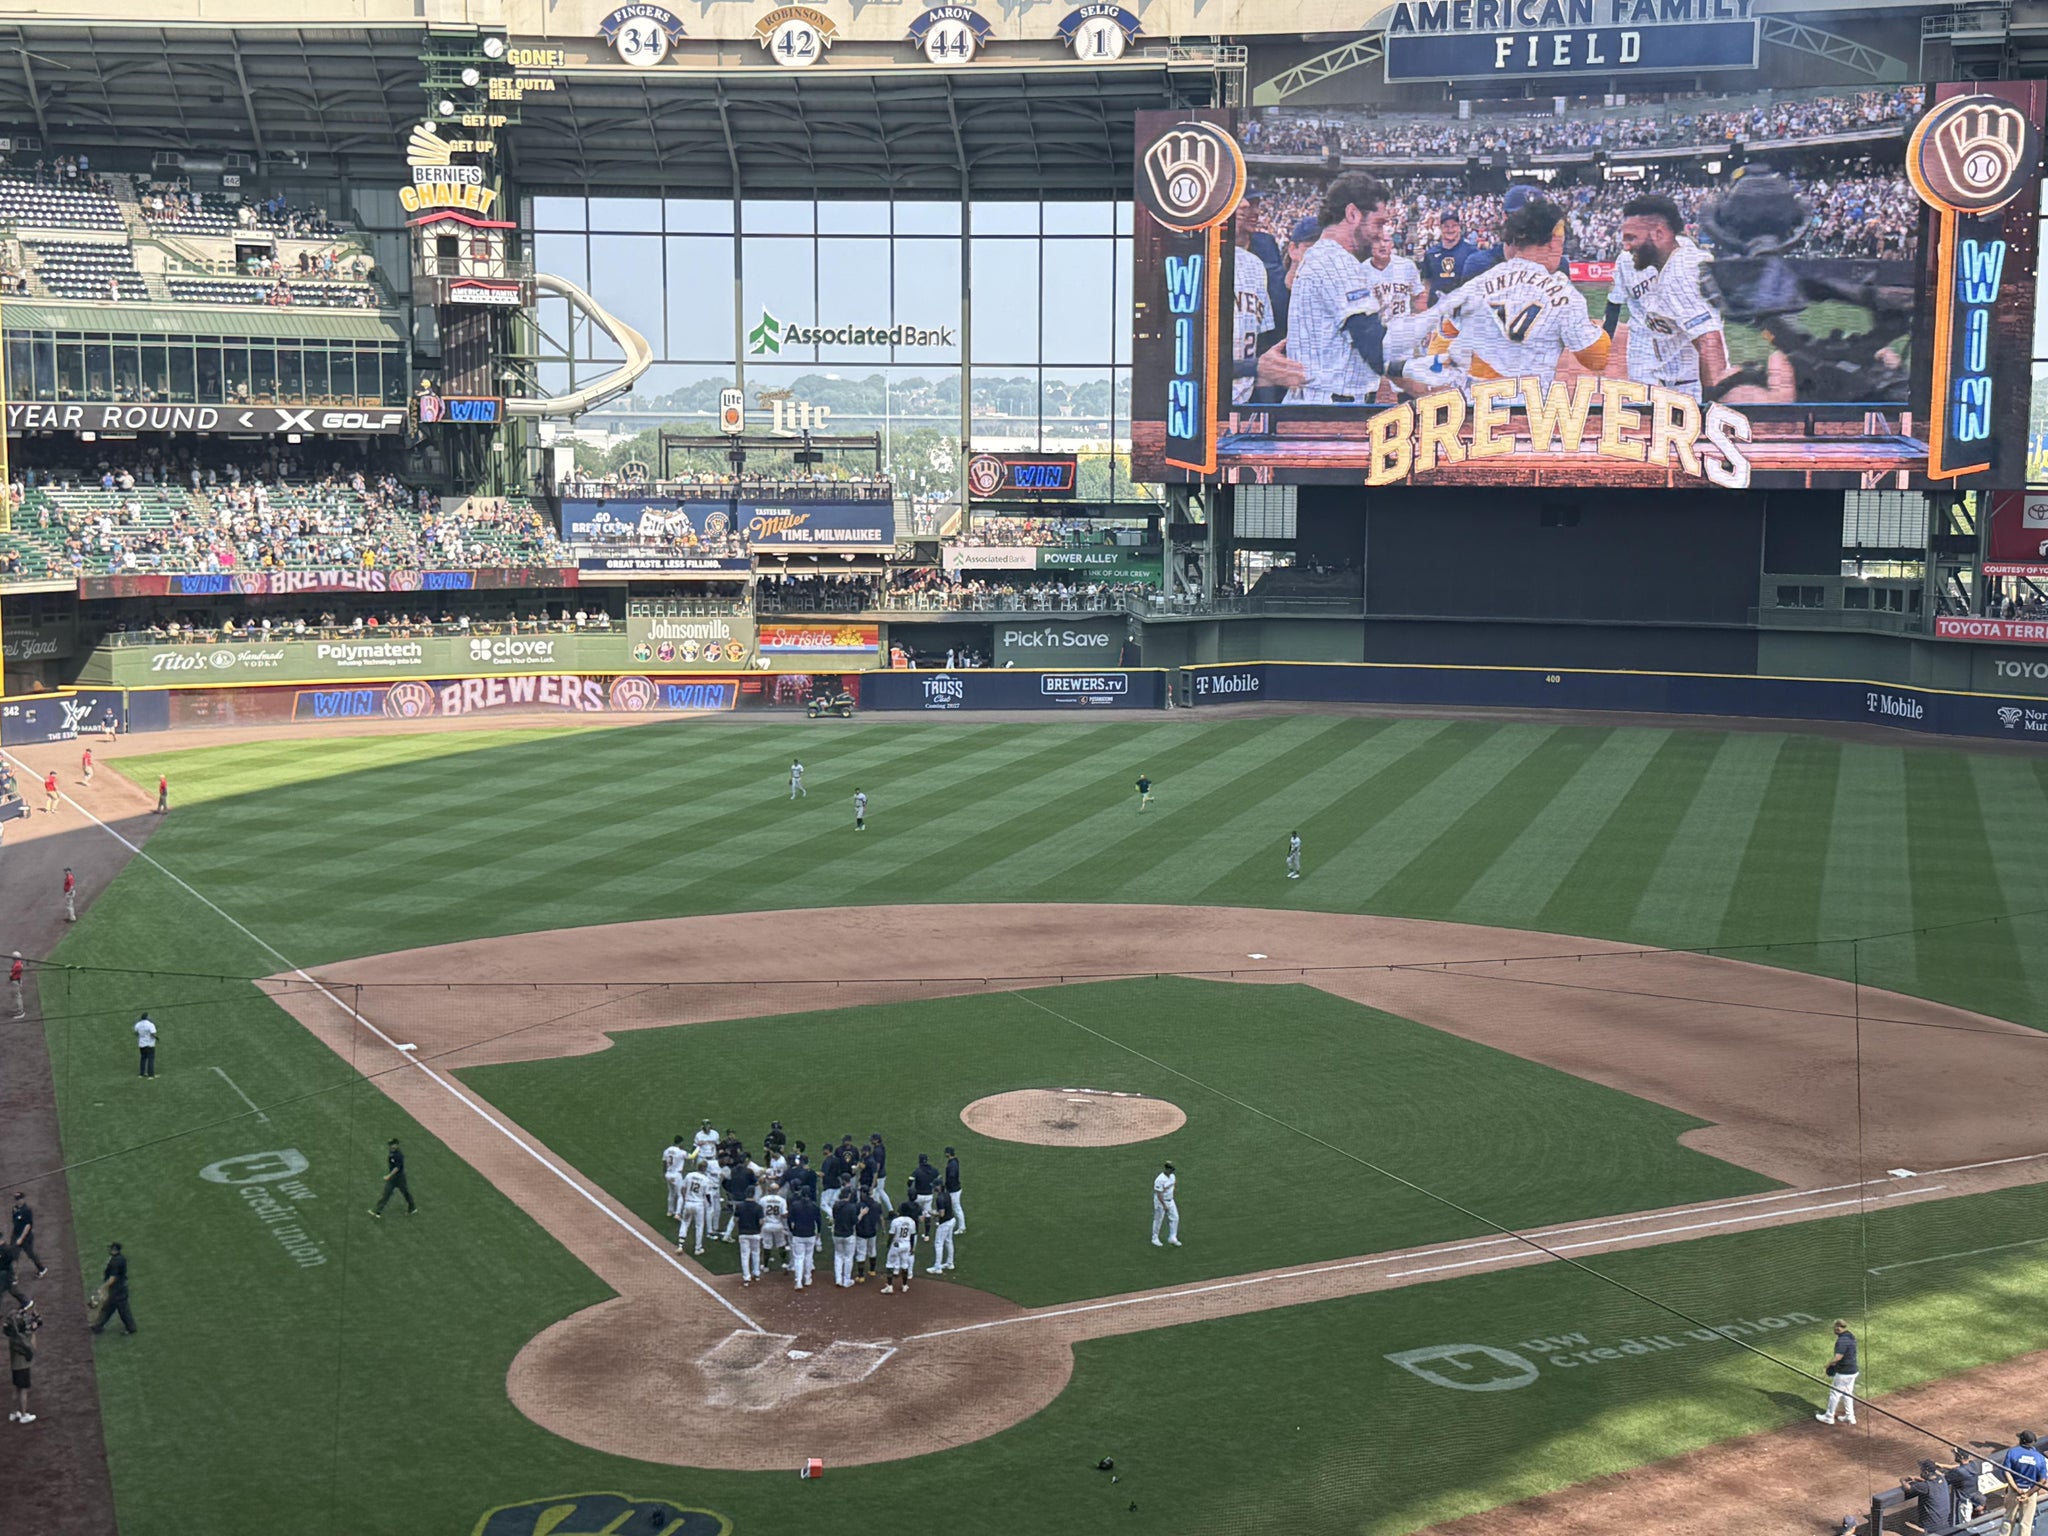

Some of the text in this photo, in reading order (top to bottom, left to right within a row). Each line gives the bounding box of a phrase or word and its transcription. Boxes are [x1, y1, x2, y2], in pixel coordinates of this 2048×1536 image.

[614, 5, 671, 23] FINGERS
[764, 9, 826, 26] ROBINSON
[928, 8, 972, 21] AARON
[1080, 5, 1119, 19] SELIG
[1390, 0, 1750, 32] AMERICAN FAMILY
[624, 29, 661, 56] 34
[777, 30, 815, 56] 42
[931, 30, 969, 57] 44
[1093, 30, 1109, 57] 1
[1494, 32, 1641, 69] FIELD
[507, 49, 565, 66] GONE!
[489, 78, 556, 91] GET OUTTA
[489, 89, 523, 100] HERE
[462, 115, 507, 127] GET UP
[450, 140, 494, 152] GET UP
[415, 167, 481, 182] BERNIE'S
[399, 183, 498, 214] CHALET
[1483, 270, 1570, 308] ONTRERAS
[723, 394, 742, 407] Lite
[7, 405, 84, 428] YEAR
[101, 406, 219, 429] ROUND
[321, 413, 403, 430] GOLF
[450, 400, 496, 421] WIN
[770, 399, 832, 438] Lite
[1365, 375, 1753, 490] BREWERS
[1014, 466, 1063, 487] WIN
[595, 512, 611, 523] GO
[755, 508, 791, 516] TASTES LIKE
[750, 513, 811, 540] Miller
[780, 529, 882, 542] TIME, MILWAUKEE
[606, 559, 722, 569] GREAT TASTE. LESS FILLING.
[1044, 553, 1119, 564] POWER ALLEY
[1984, 565, 2025, 574] COURTESY
[2026, 566, 2038, 574] OF
[180, 574, 223, 593] WIN
[270, 569, 386, 594] BREWERS
[427, 572, 469, 590] WIN
[647, 619, 730, 640] Johnsonville
[772, 628, 833, 648] Surfside
[1939, 621, 2001, 637] TOYOTA
[493, 637, 555, 656] clover
[1003, 630, 1043, 647] Pick
[1062, 630, 1109, 647] Save
[21, 638, 58, 659] Yard
[237, 649, 284, 660] Handmade
[317, 642, 422, 660] Polymatech
[152, 651, 207, 672] Tito's
[243, 660, 279, 668] VODKA
[1995, 660, 2048, 678] TOYO
[1211, 673, 1260, 694] Mobile
[1545, 674, 1561, 683] 400
[440, 674, 605, 717] BREWERS
[667, 684, 725, 710] WIN
[921, 680, 963, 699] TRUSS
[3, 705, 20, 717] 342
[313, 690, 374, 717] WIN
[1880, 694, 1924, 720] Mobile
[2024, 709, 2048, 720] Nor
[690, 1181, 701, 1193] 12
[899, 1227, 909, 1238] 18
[1549, 1310, 1822, 1368] credit union
